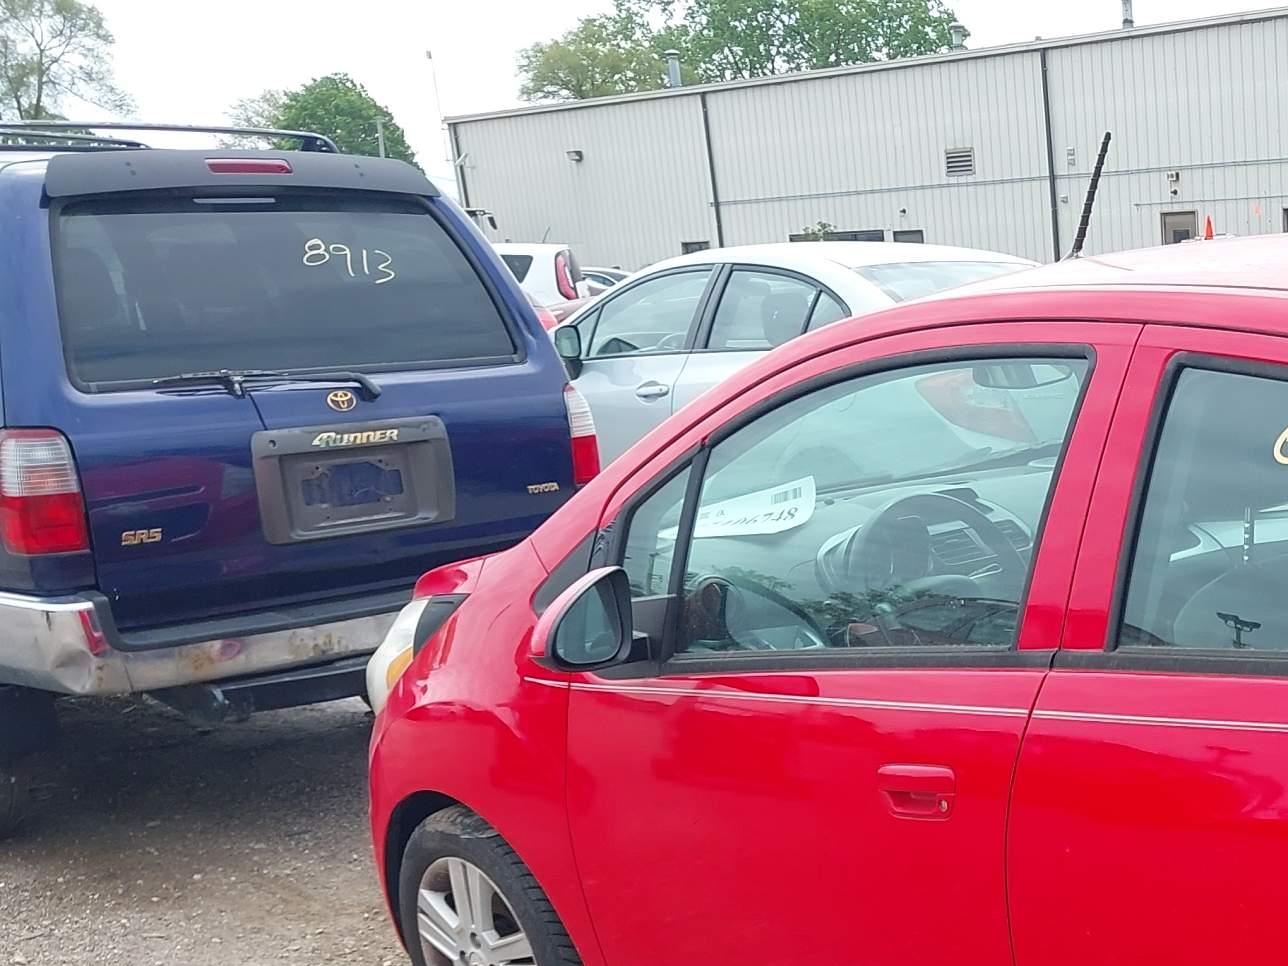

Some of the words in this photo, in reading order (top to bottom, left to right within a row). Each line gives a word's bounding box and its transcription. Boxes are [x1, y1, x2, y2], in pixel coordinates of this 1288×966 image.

[303, 238, 395, 284] 8913
[526, 482, 560, 494] TOYOTA
[121, 527, 163, 546] SR5
